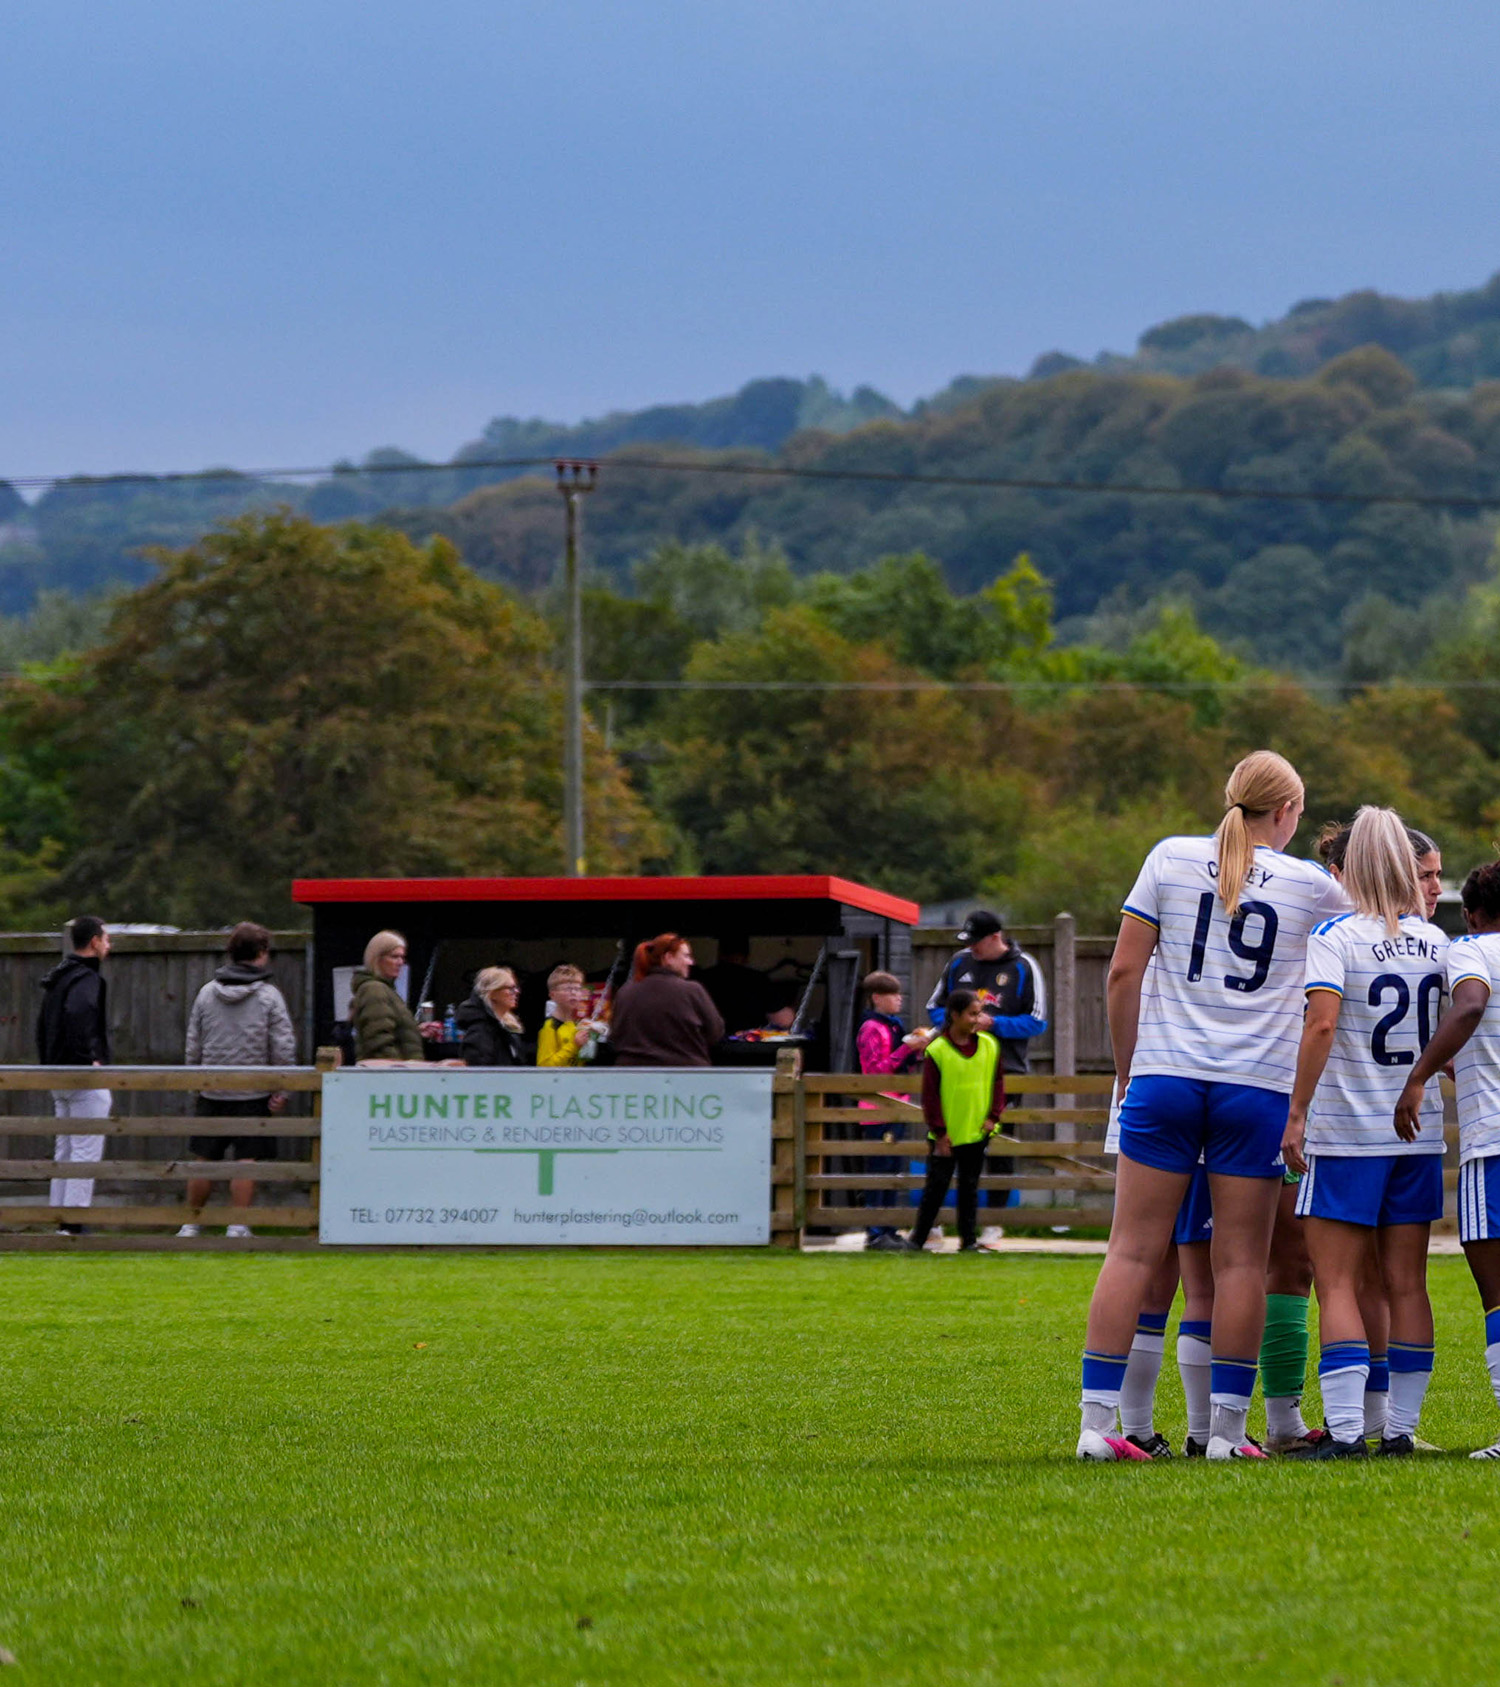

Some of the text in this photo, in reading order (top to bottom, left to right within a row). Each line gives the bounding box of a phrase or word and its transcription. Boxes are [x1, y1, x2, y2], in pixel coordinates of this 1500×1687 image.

[1187, 892, 1278, 993] 19
[1371, 937, 1438, 962] GREENE
[1368, 973, 1443, 1066] 20
[369, 1094, 723, 1120] HUNTER PLASTERING
[369, 1126, 724, 1144] PLASTERING & RENDERING SOLUTIONS
[350, 1208, 739, 1227] TEL: 07732 394007 hunterplastering@outlook.com
